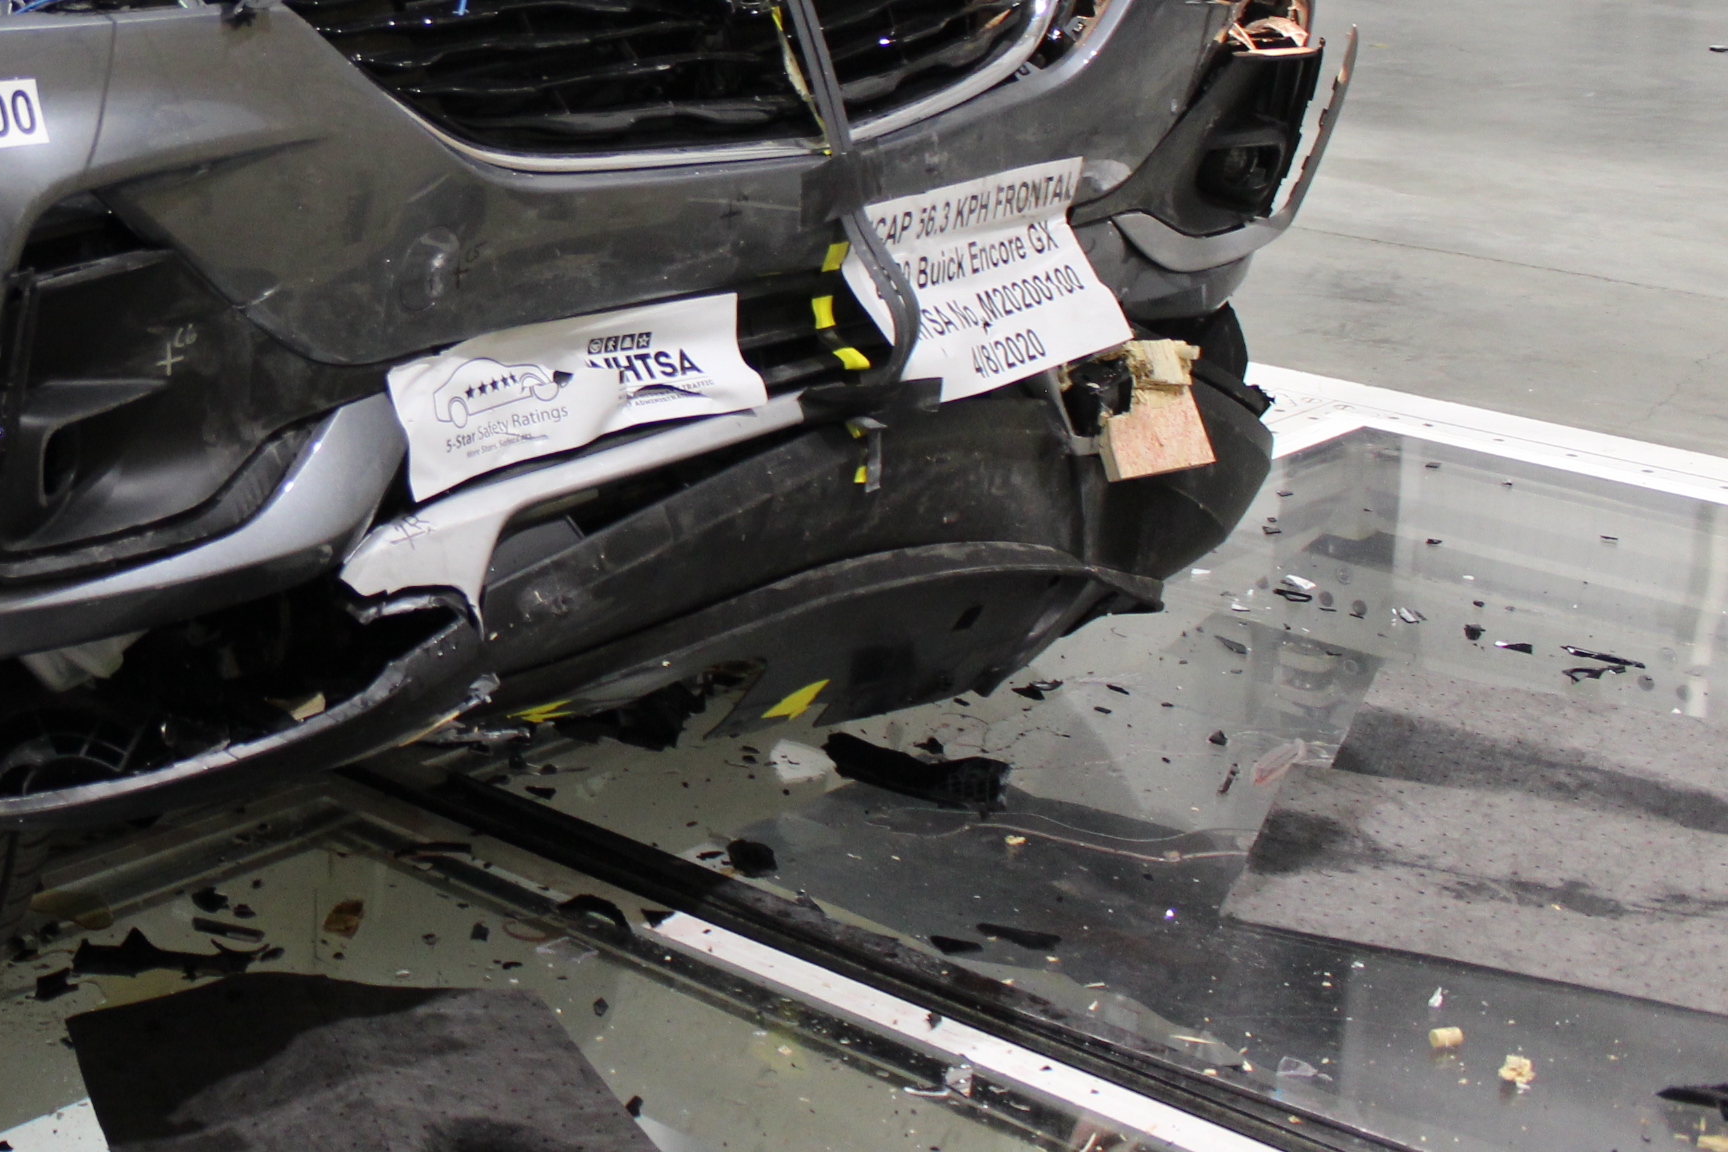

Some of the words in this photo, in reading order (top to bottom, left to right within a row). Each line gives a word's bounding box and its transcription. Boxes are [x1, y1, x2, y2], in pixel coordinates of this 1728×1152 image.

[872, 211, 912, 246] CAP
[916, 201, 951, 240] 56.3
[952, 189, 990, 231] KPH
[993, 171, 1073, 222] FRONTAL
[917, 246, 966, 289] Buick
[967, 237, 1027, 276] Encore
[1027, 220, 1059, 254] GX
[975, 264, 1085, 322] M20200100
[971, 328, 1047, 379] 4/8/2020
[446, 432, 476, 454] 5-Star
[478, 420, 508, 441] Safety
[511, 406, 568, 428] Ratings
